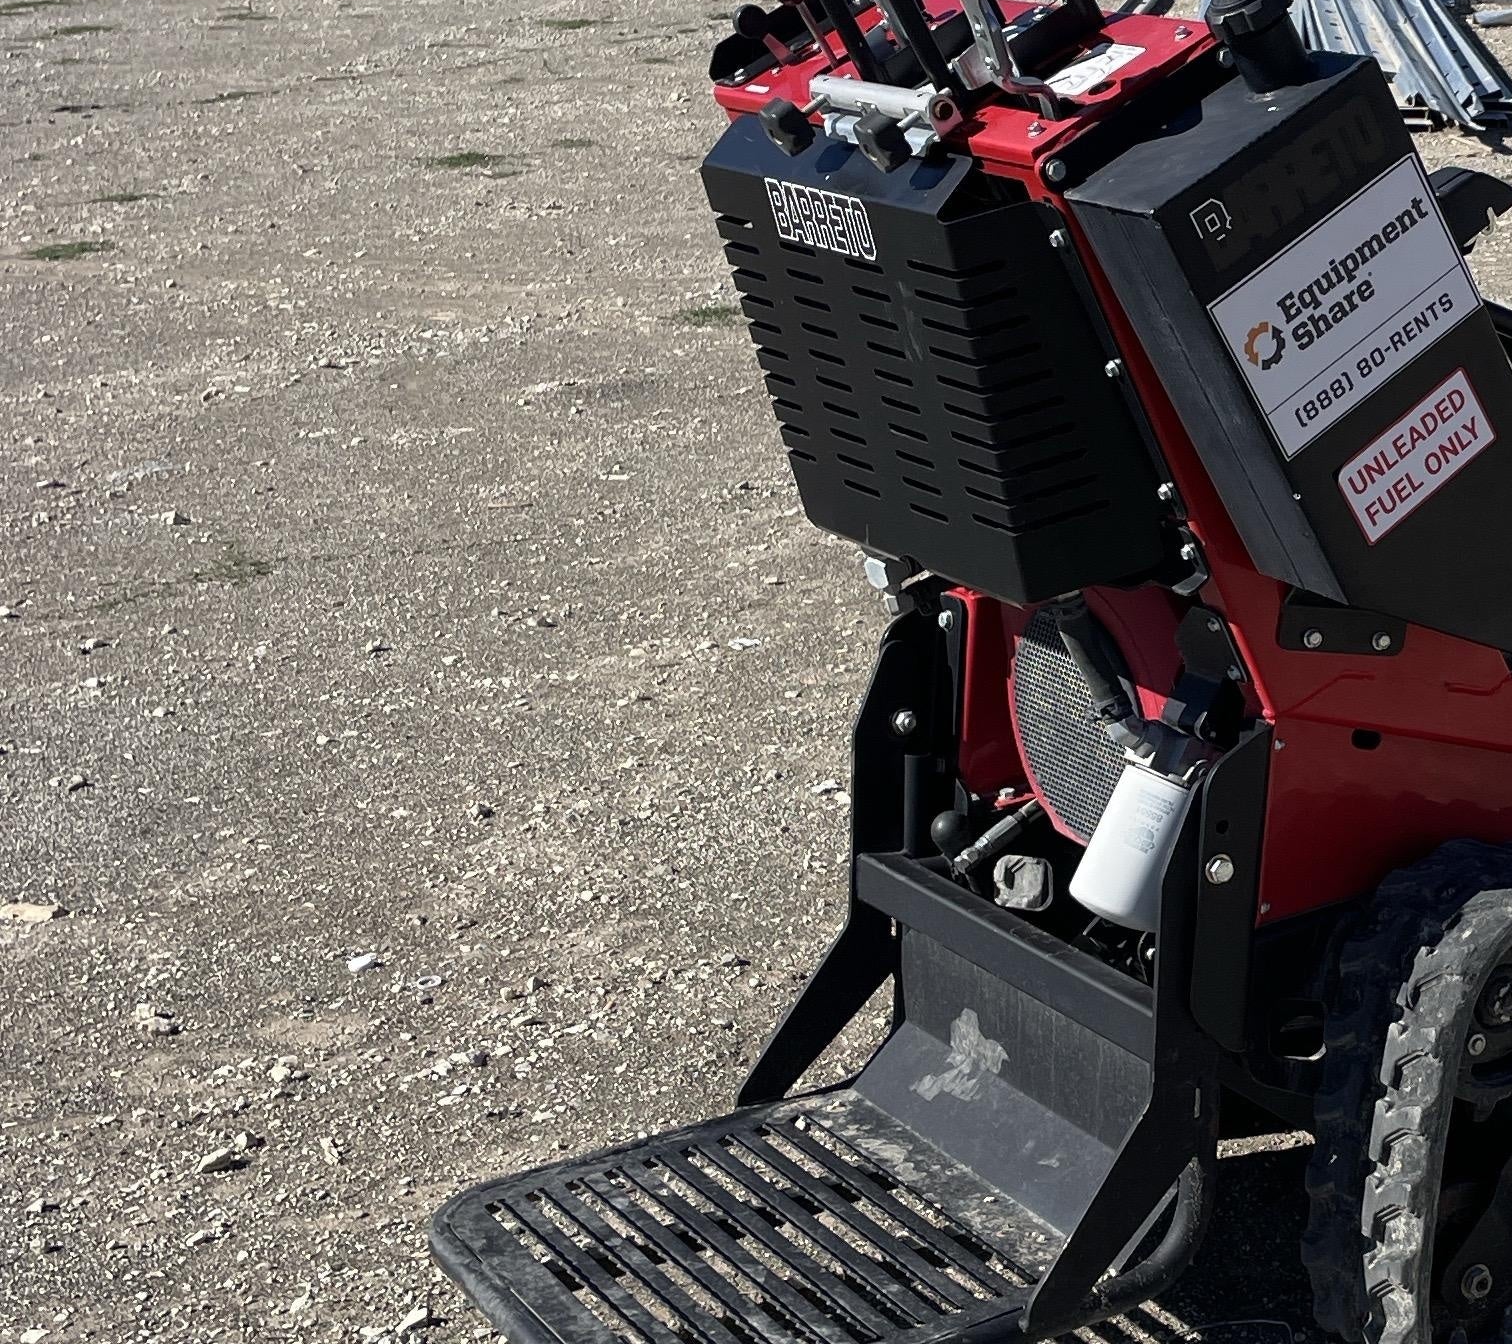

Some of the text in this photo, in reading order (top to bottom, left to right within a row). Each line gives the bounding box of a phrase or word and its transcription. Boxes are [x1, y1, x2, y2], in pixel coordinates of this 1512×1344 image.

[763, 176, 878, 262] BARRETO
[1276, 196, 1429, 325] Equipment
[1291, 278, 1376, 351] Share
[1294, 292, 1454, 428] (888) 80-RENTS
[1347, 388, 1466, 495] UNLEADED
[1364, 415, 1479, 527] FUEL ONLY
